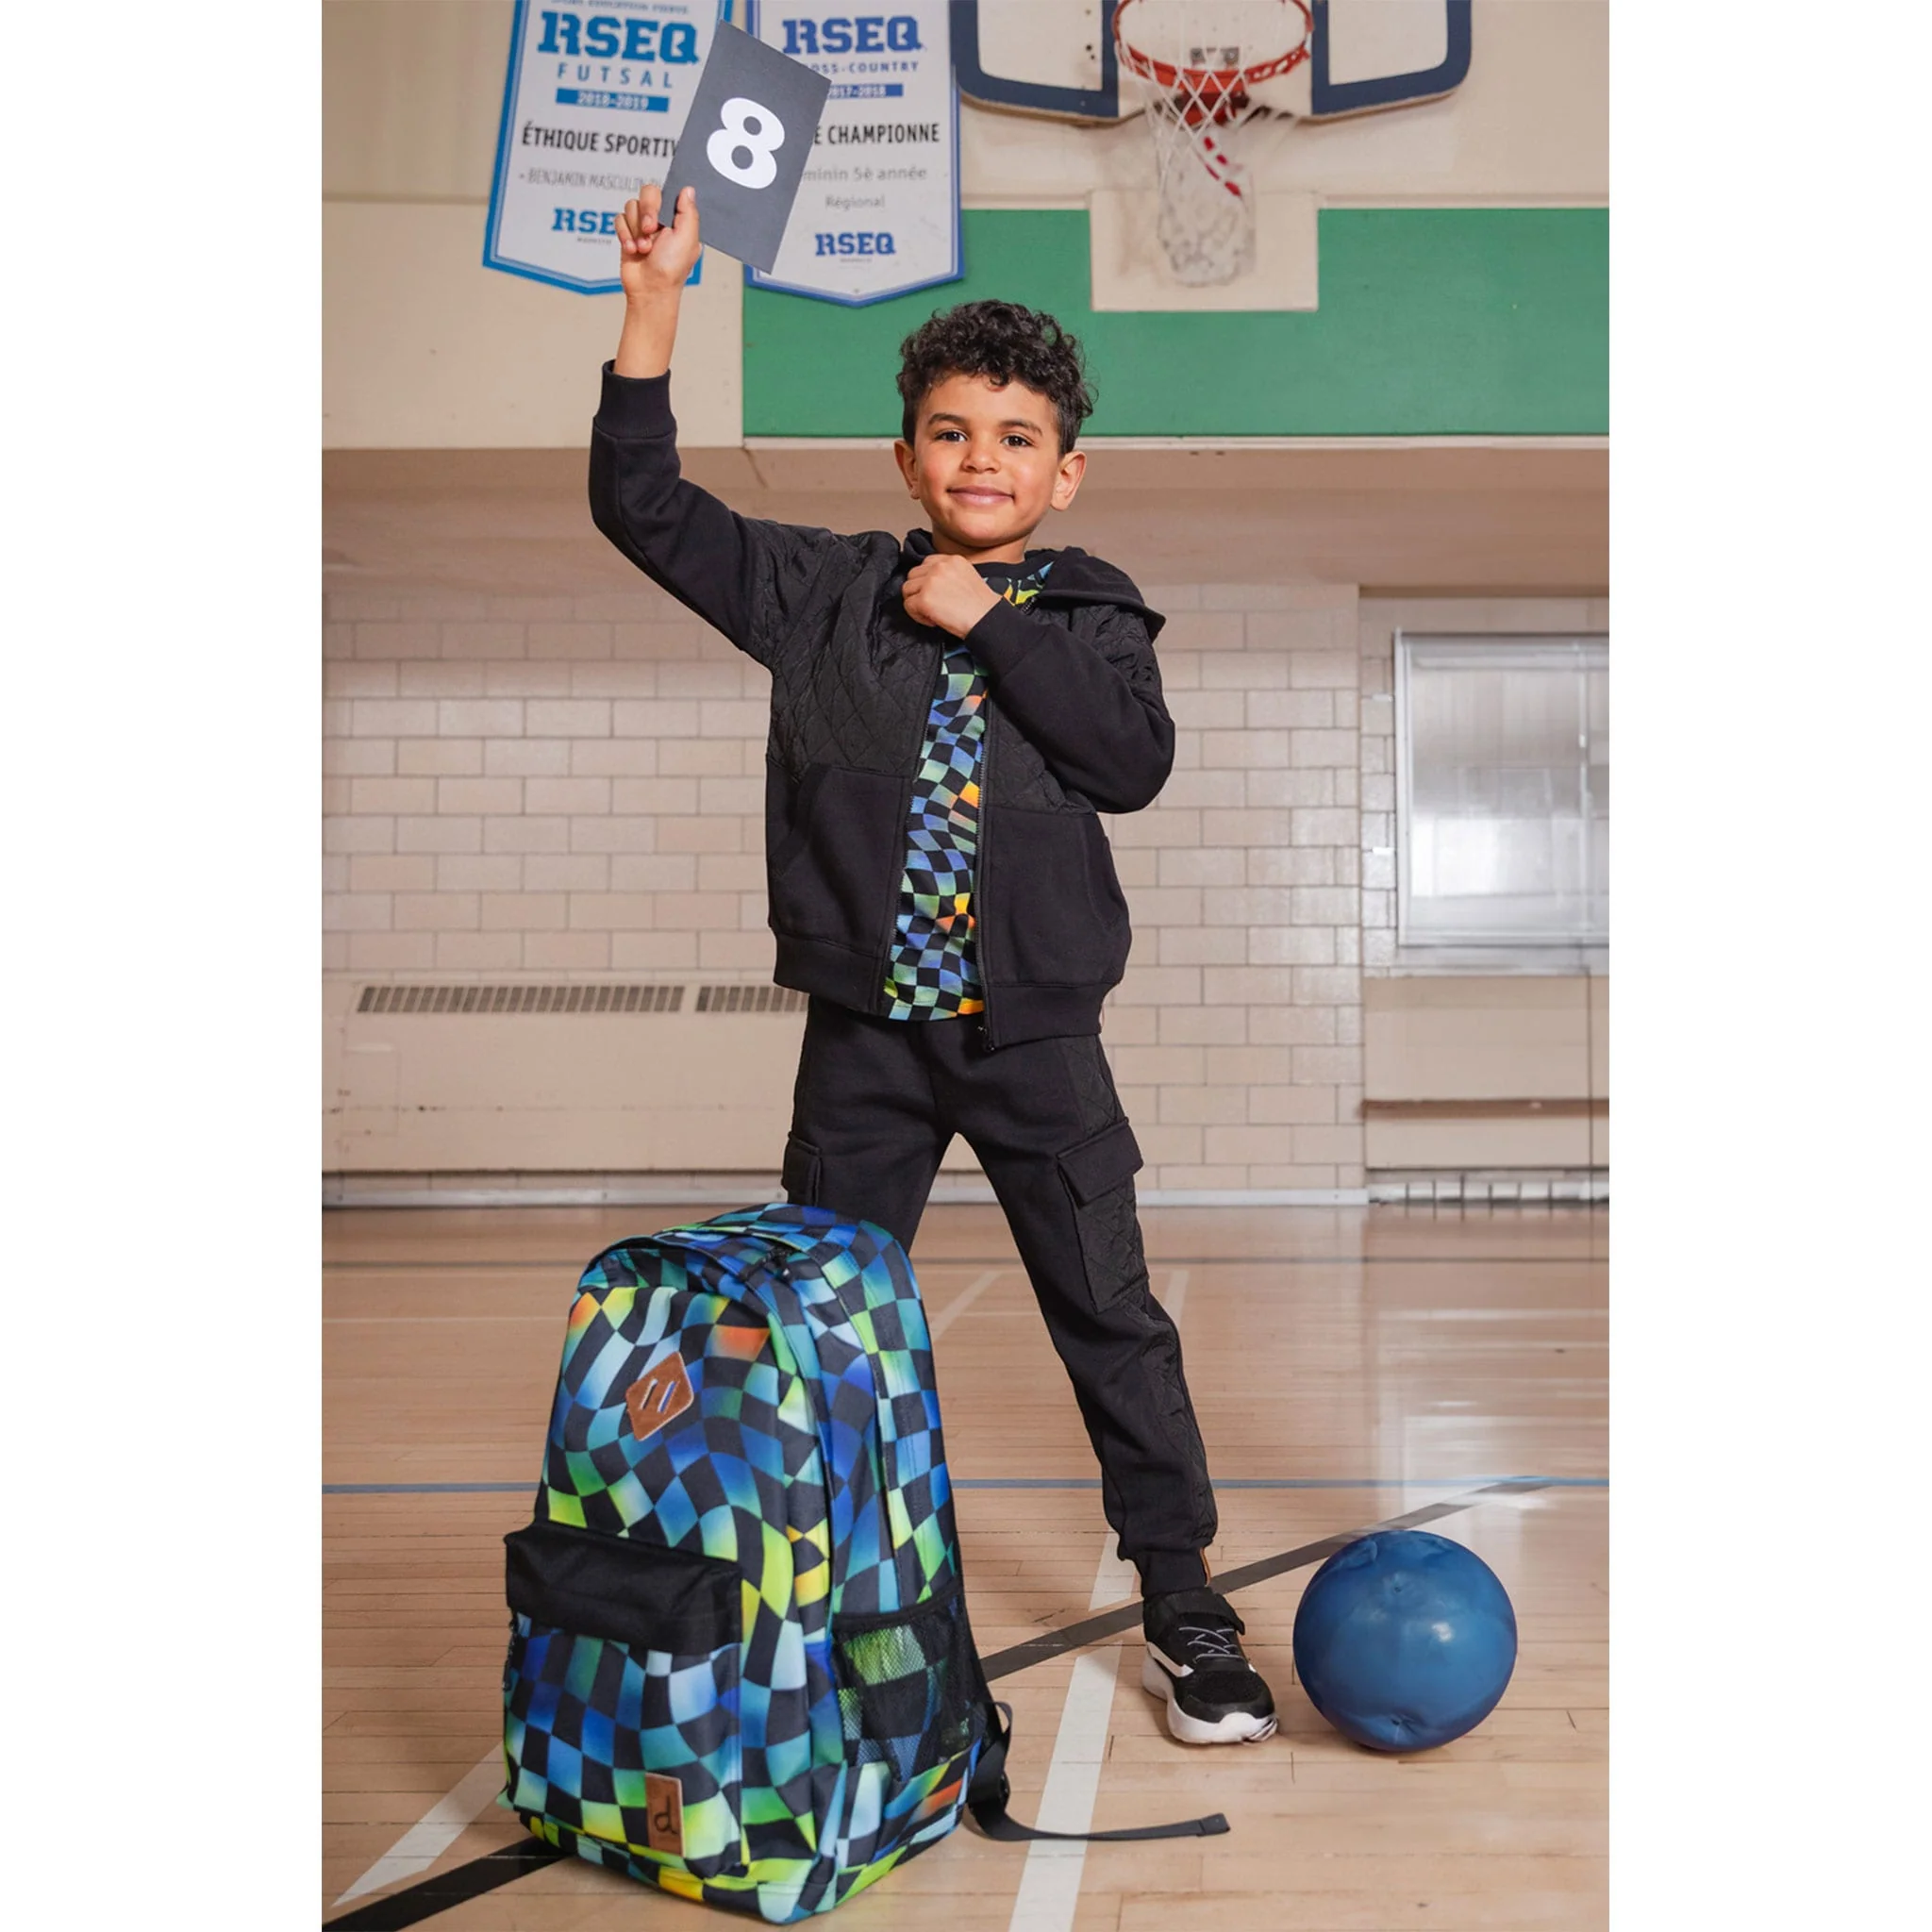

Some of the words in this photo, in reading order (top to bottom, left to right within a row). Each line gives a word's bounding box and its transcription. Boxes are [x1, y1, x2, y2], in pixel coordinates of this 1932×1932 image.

[538, 11, 699, 64] RSEQ
[782, 15, 922, 54] RSEQ
[558, 63, 673, 89] FUTSAL
[809, 61, 919, 75] OSS-COUNTRY
[522, 120, 599, 152] ÉTHIQUE
[707, 97, 785, 189] 8
[827, 123, 941, 144] CHAMPIONNE
[877, 164, 927, 181] année
[552, 208, 618, 236] RSE
[815, 232, 897, 257] RSEQ
[654, 1795, 678, 1835] d
